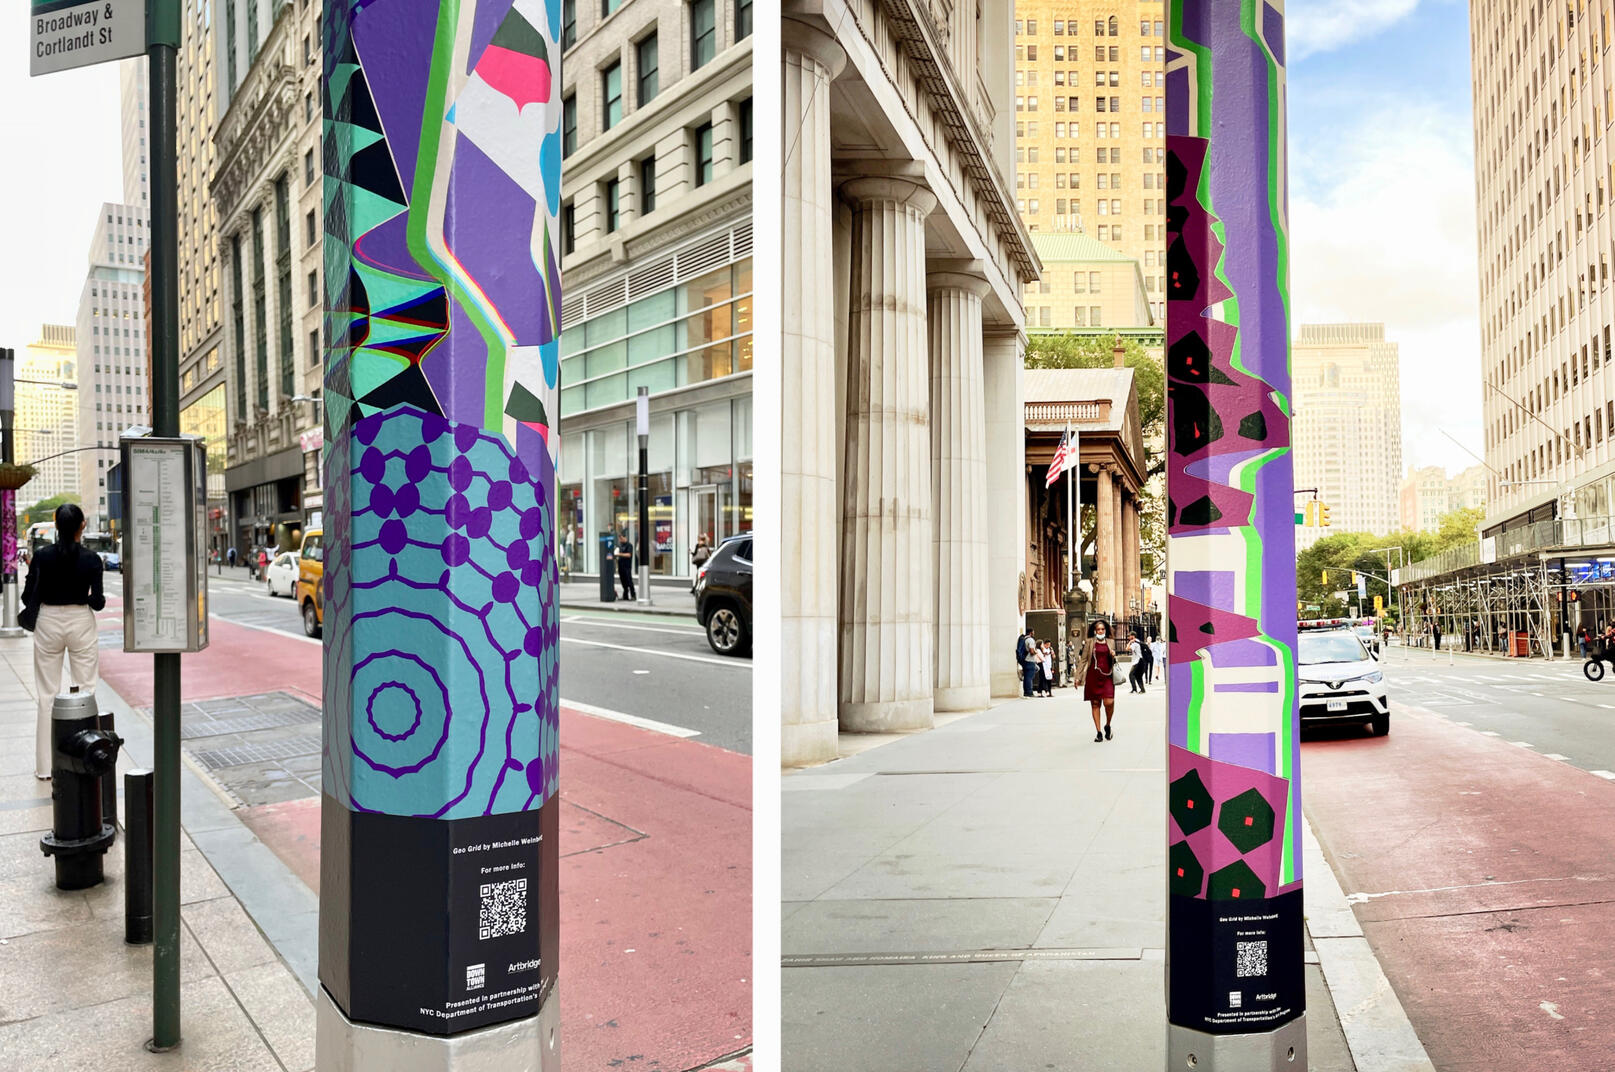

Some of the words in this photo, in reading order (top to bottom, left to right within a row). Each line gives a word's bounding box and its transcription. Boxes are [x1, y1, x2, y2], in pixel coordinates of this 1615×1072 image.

[36, 9, 98, 35] Broadway
[104, 3, 112, 20] &
[36, 31, 94, 58] Cortlandt
[100, 27, 112, 44] St
[492, 840, 520, 849] Michelle
[467, 967, 485, 979] DOWN
[467, 976, 485, 987] TOWN
[420, 1008, 434, 1016] NYC
[436, 1007, 477, 1019] Department
[487, 993, 538, 1010] Transportation's
[446, 996, 480, 1009] Presented
[490, 987, 526, 1000] partnership
